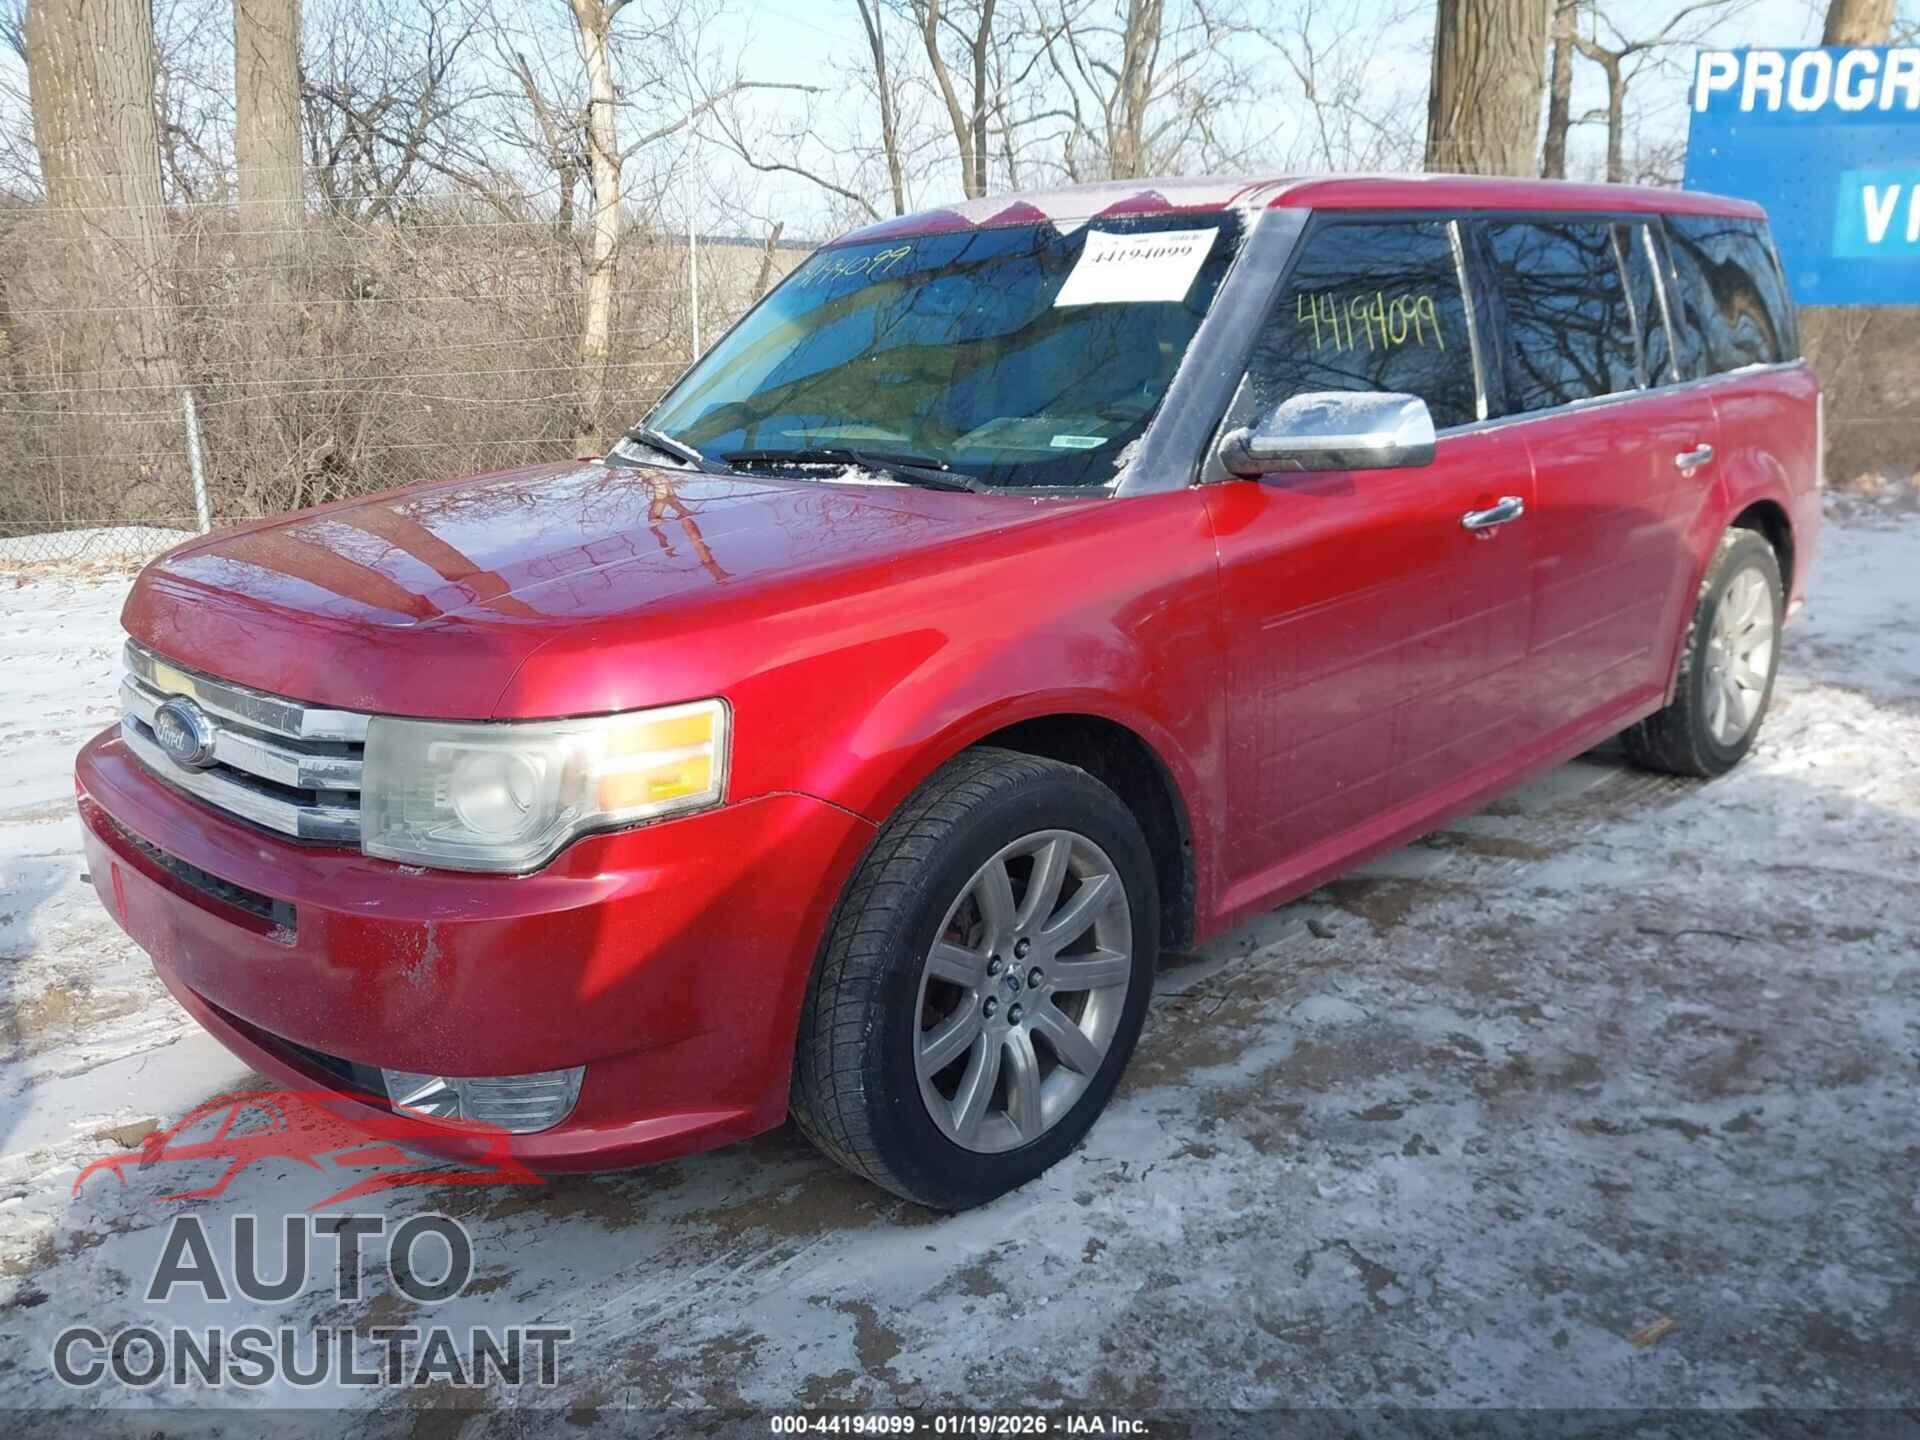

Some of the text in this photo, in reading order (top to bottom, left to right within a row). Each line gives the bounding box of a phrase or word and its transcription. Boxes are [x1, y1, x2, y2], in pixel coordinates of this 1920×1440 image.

[1695, 49, 1920, 113] PROGR
[1092, 245, 1193, 264] 44194099
[1297, 291, 1445, 352] 44194099
[160, 711, 186, 751] Ford
